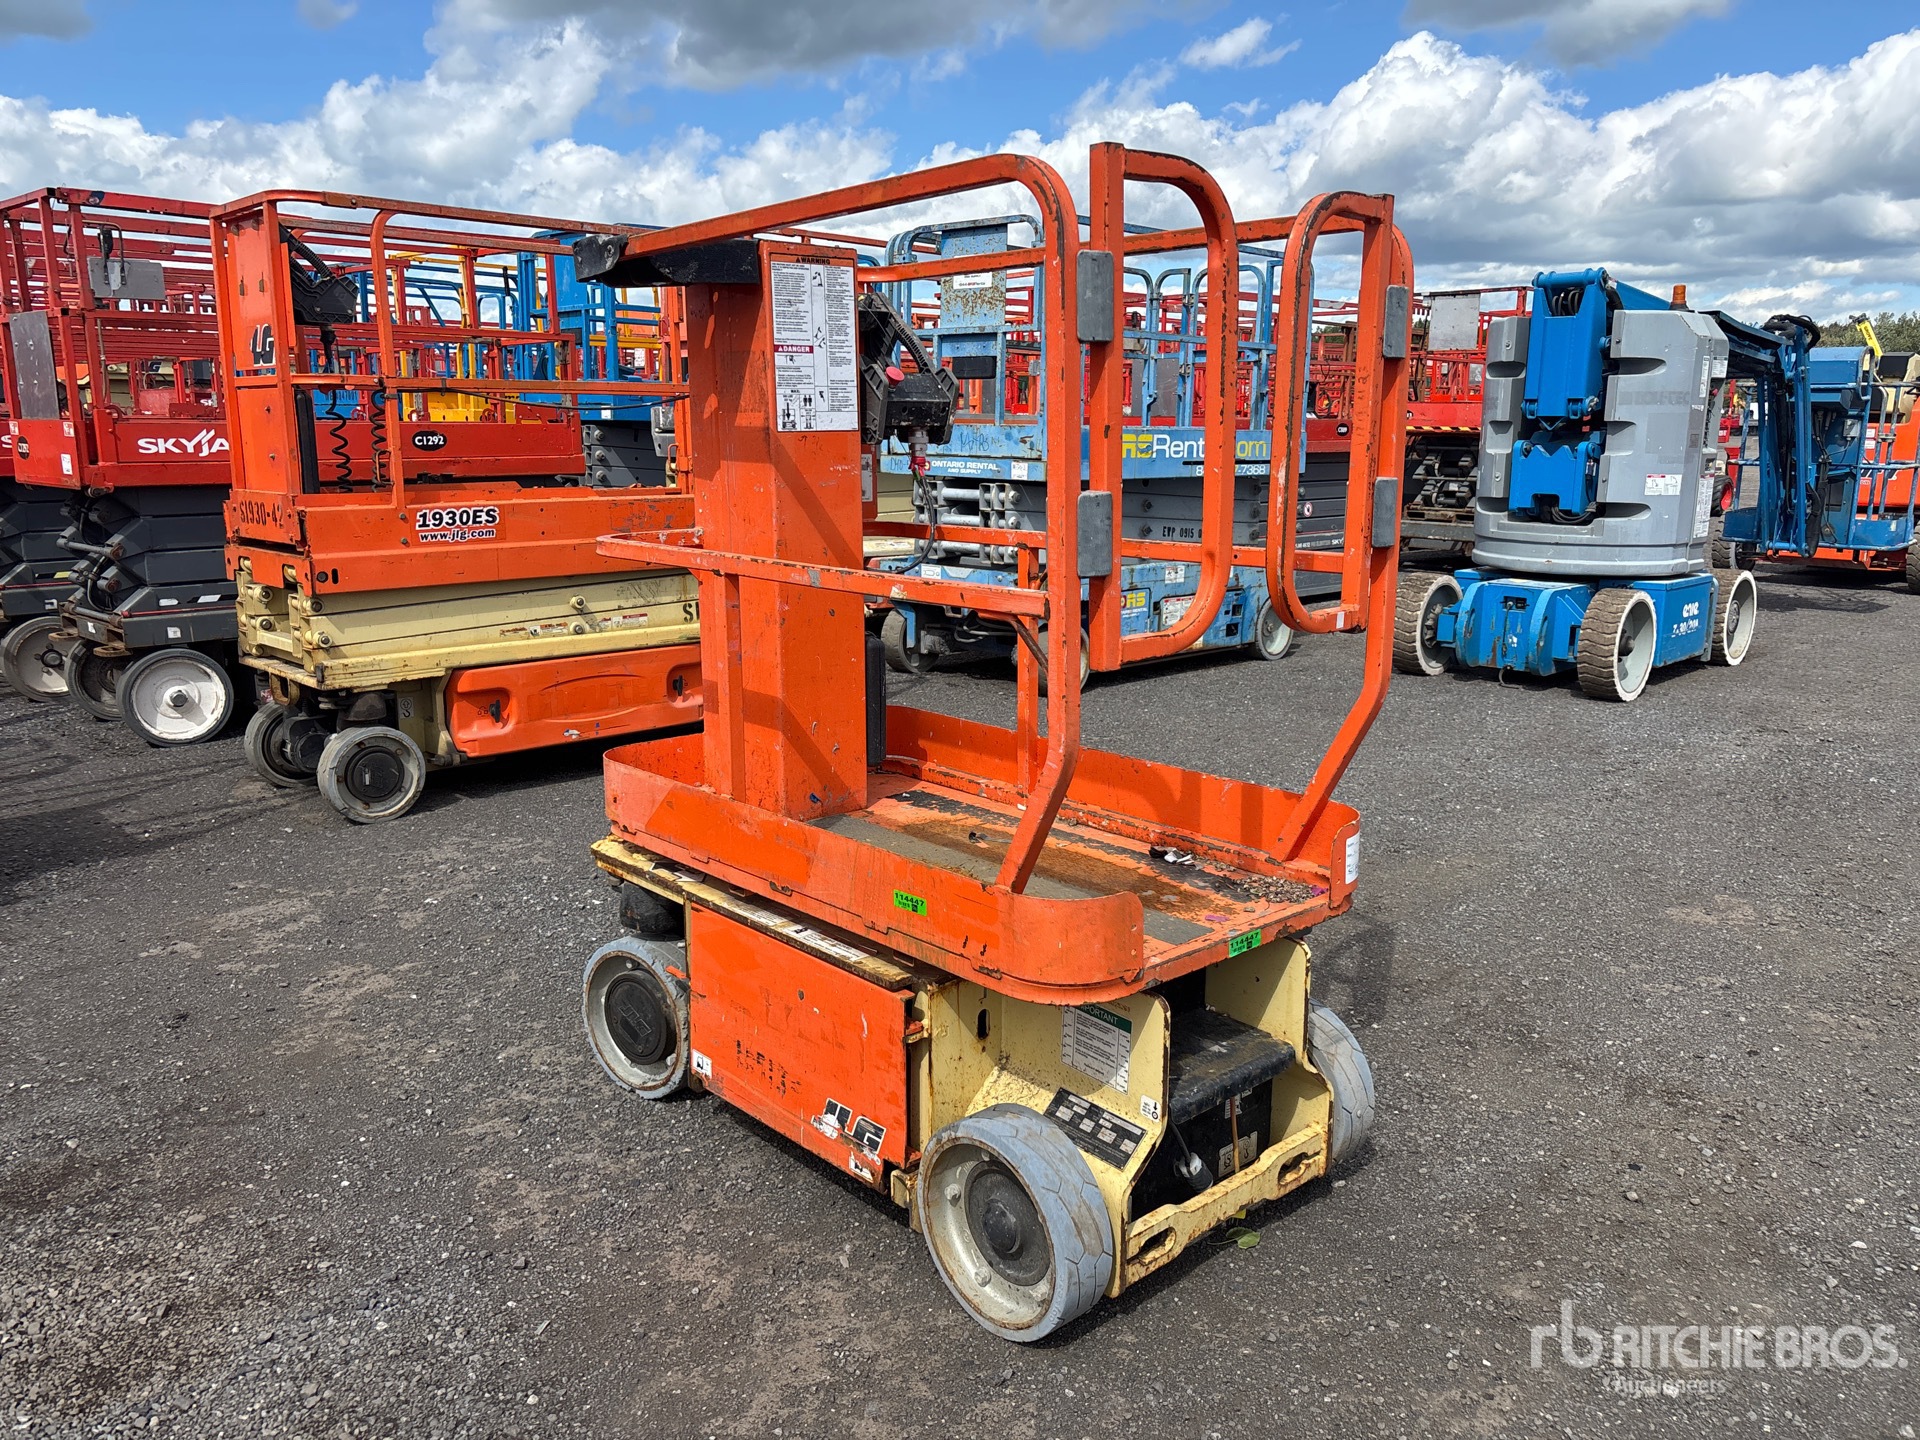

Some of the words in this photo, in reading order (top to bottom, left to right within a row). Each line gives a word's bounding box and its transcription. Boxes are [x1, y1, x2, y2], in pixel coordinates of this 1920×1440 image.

[801, 257, 831, 265] WARNING
[414, 436, 445, 446] C1292
[931, 460, 964, 469] ONTARIO
[967, 461, 999, 470] RENTAL
[417, 507, 498, 529] 1930ES
[420, 529, 495, 541] www.jlg.com
[894, 892, 925, 907] 114447
[1230, 931, 1260, 949] 114447
[1080, 1004, 1118, 1025] PORTANT
